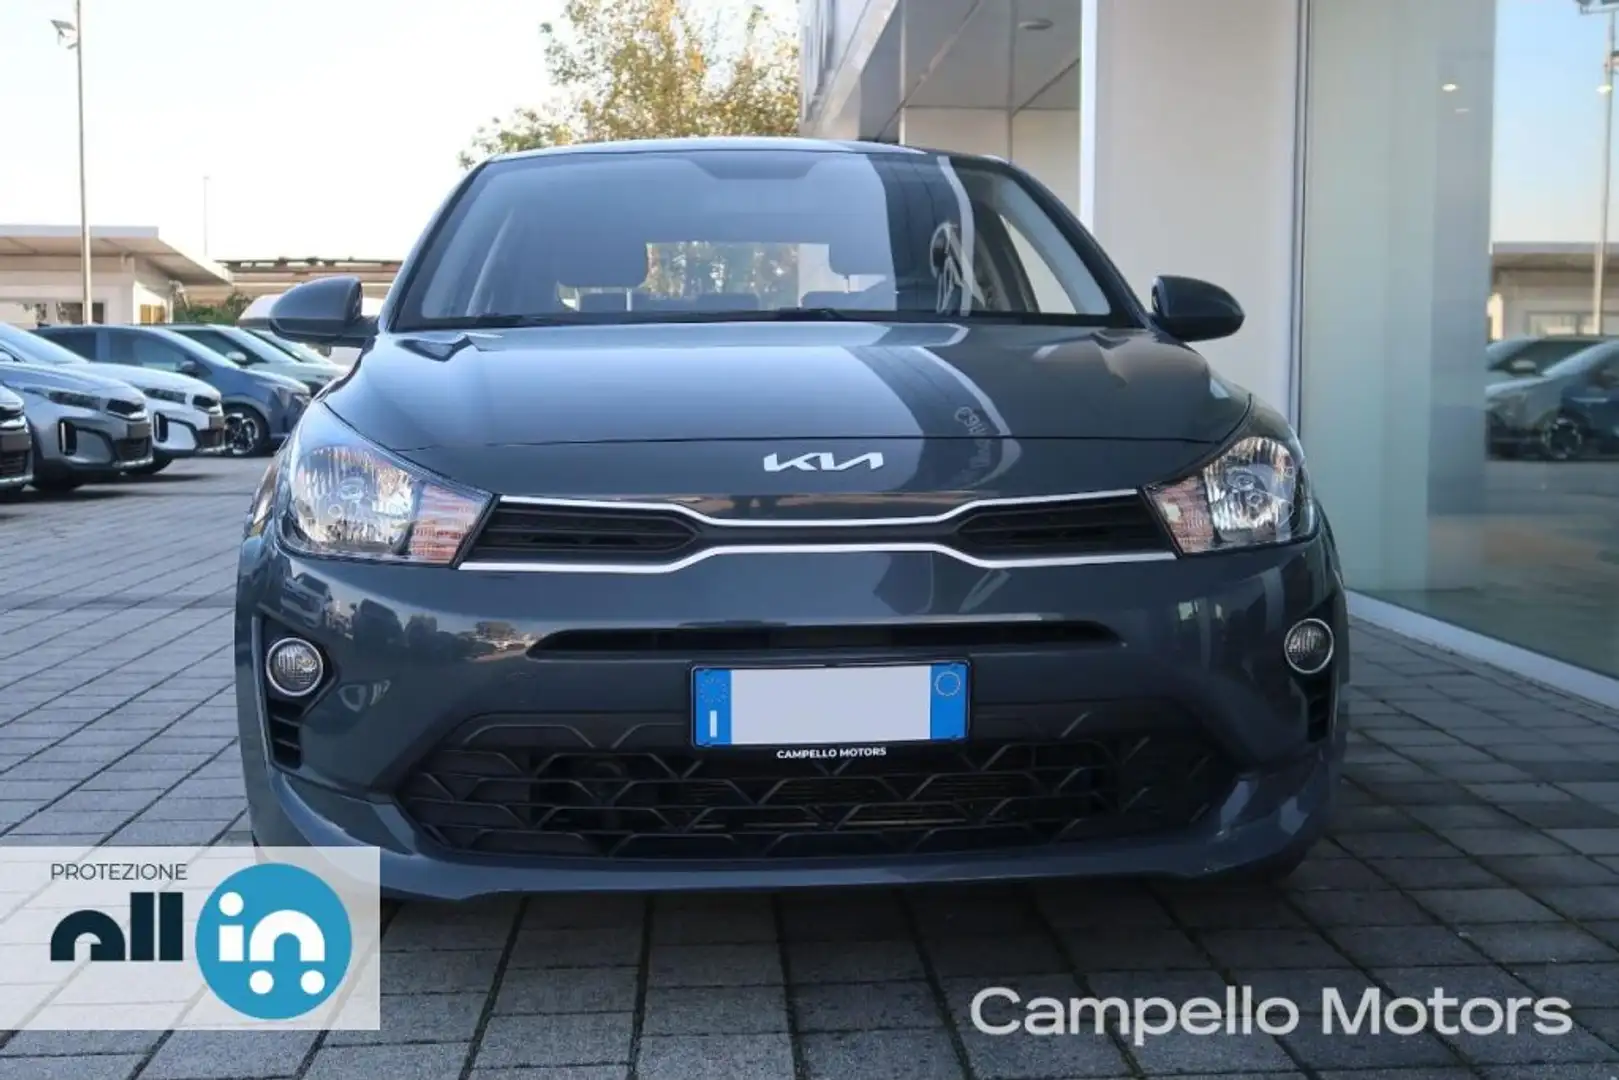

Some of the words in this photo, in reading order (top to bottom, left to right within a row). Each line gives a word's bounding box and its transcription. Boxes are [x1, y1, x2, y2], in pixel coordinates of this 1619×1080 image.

[763, 452, 884, 472] KIA
[776, 748, 838, 760] CAMPELLO
[839, 746, 887, 759] MOTORS
